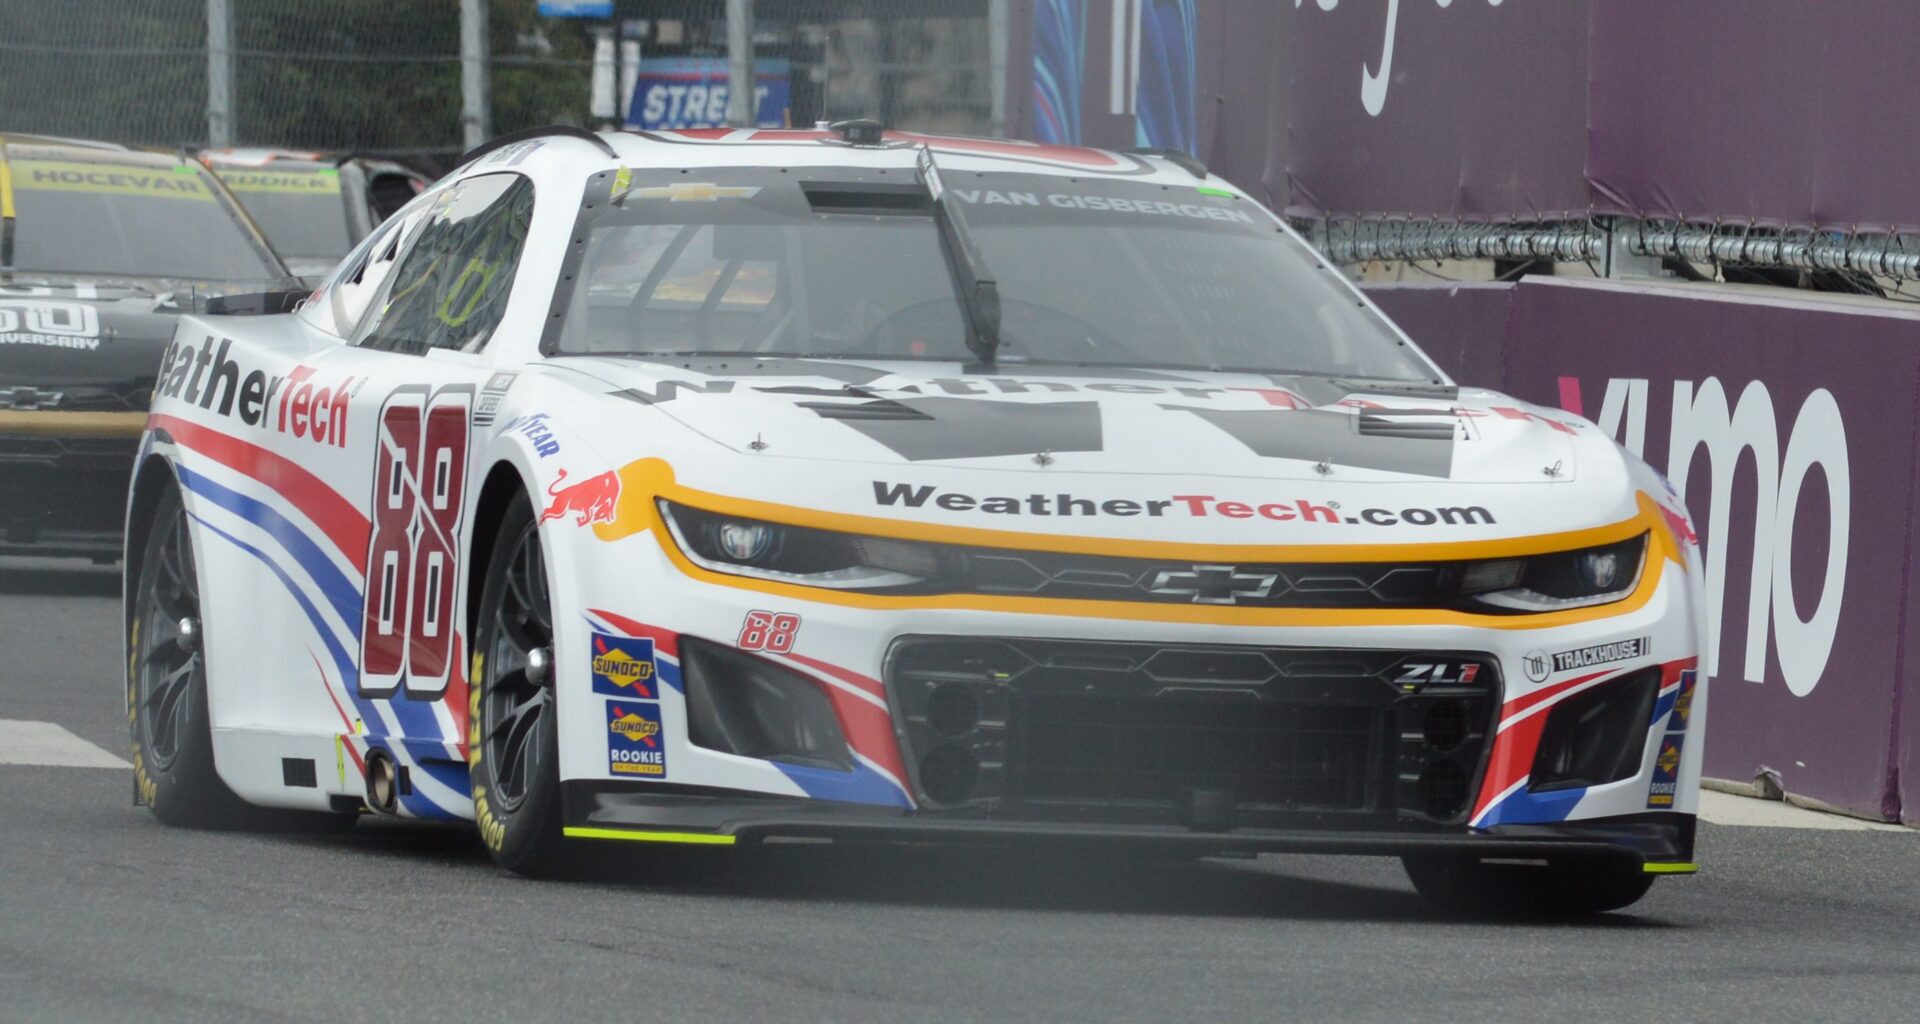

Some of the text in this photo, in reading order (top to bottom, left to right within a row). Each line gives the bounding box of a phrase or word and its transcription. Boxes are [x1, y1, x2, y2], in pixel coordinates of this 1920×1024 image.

[643, 84, 768, 122] STRET
[32, 169, 201, 193] HOCEVAR
[222, 173, 329, 188] EDDICK
[953, 189, 1254, 224] VAN GISBERGEN
[158, 335, 362, 449] eatherTech
[357, 383, 477, 702] 88
[738, 609, 802, 655] 88
[594, 657, 651, 679] SUNOCO
[1556, 639, 1640, 672] TRACKHOUSE
[1394, 663, 1481, 684] ZL1
[612, 720, 657, 735] SUNOCO
[611, 748, 663, 764] ROOKIE
